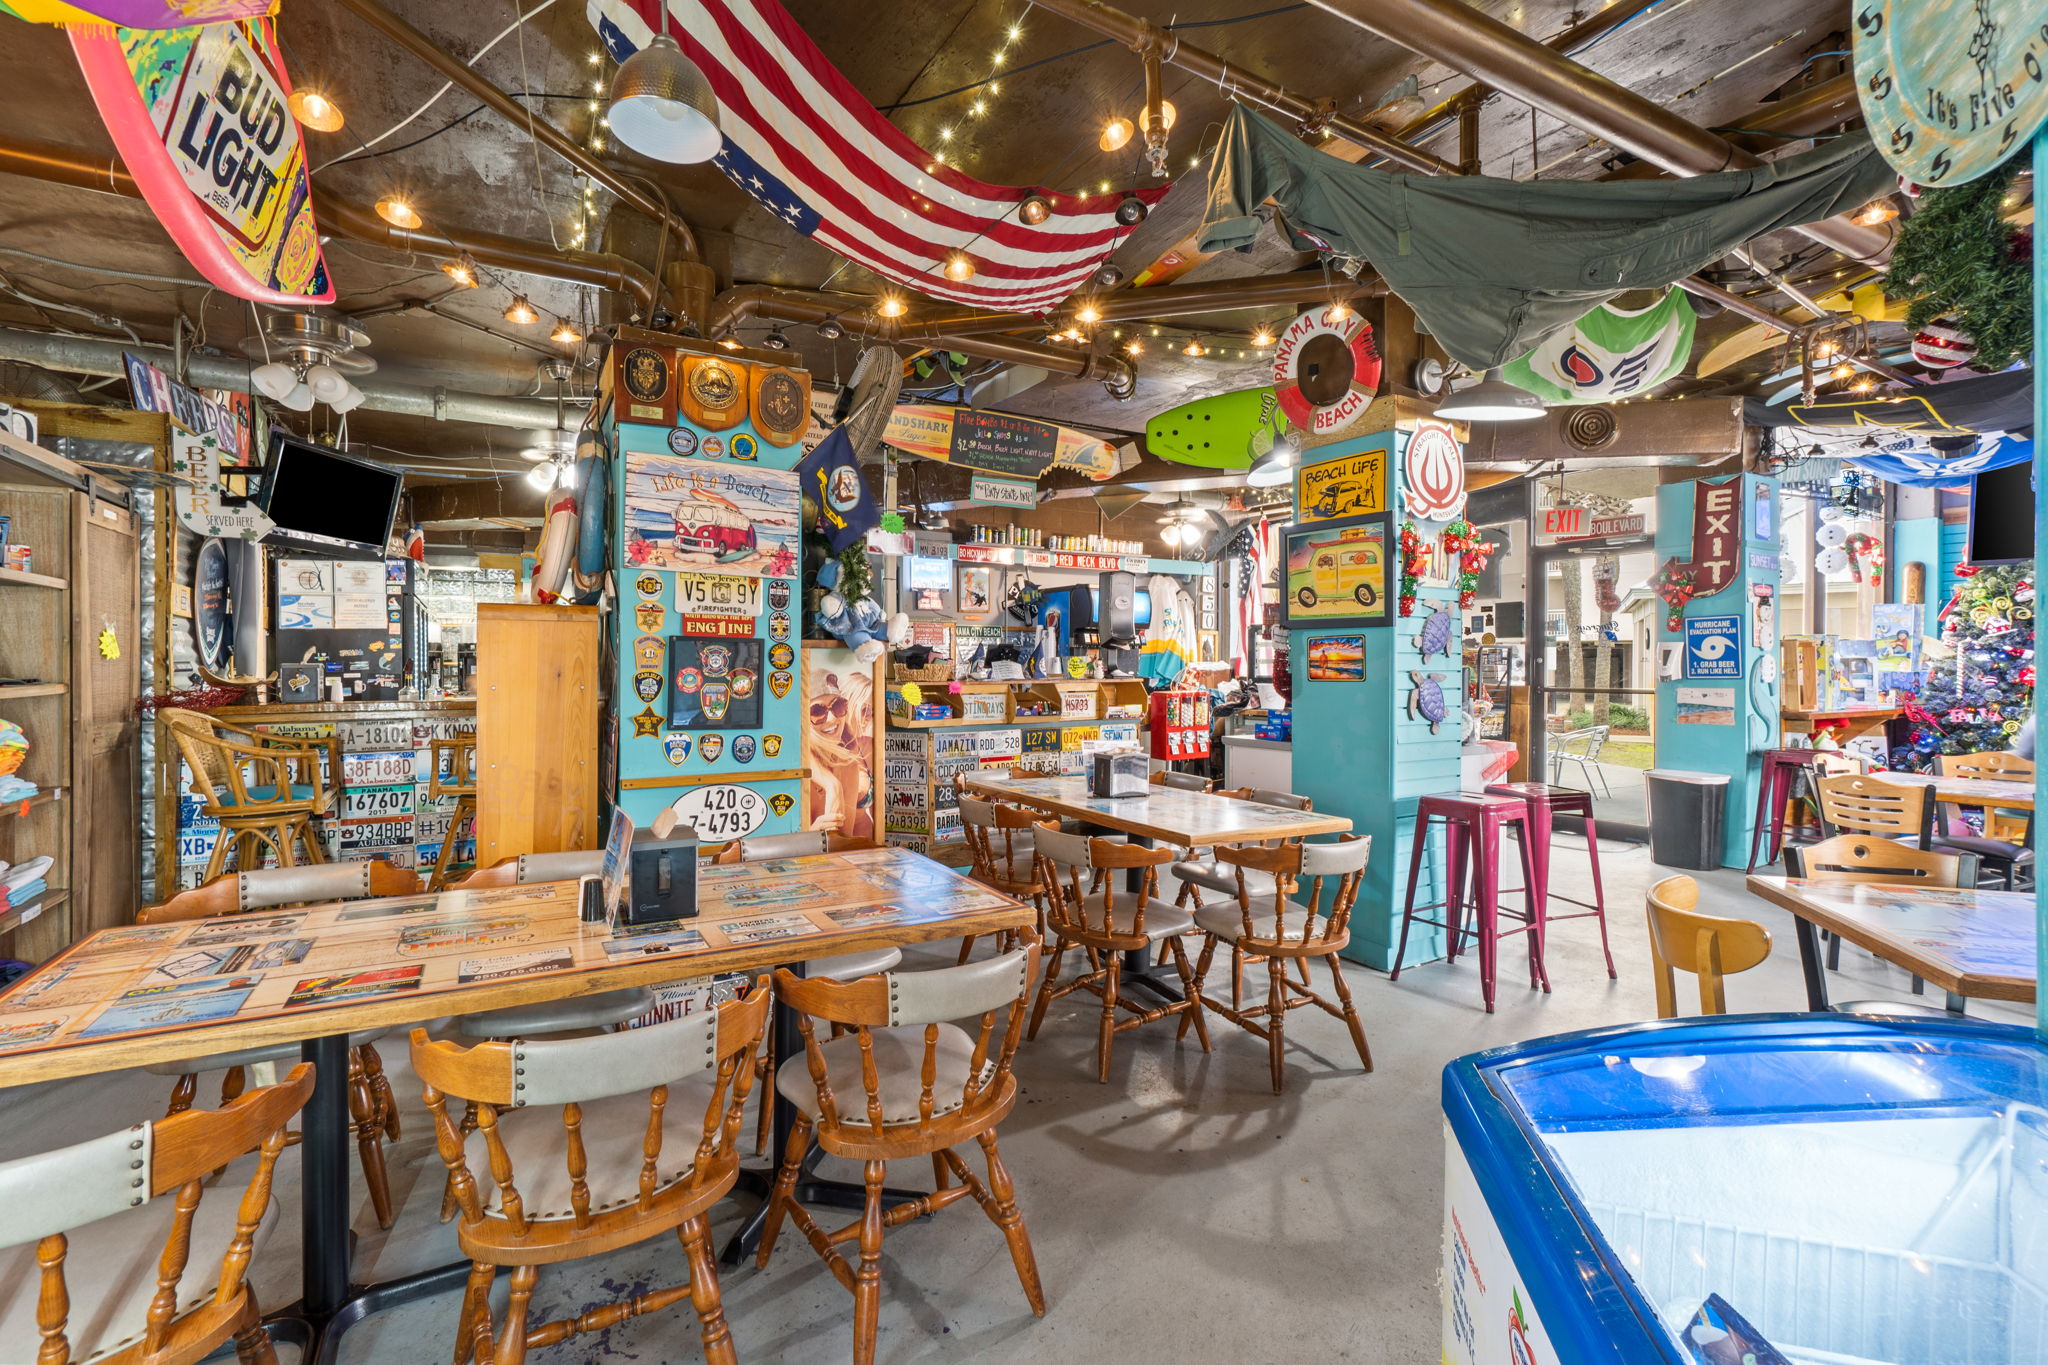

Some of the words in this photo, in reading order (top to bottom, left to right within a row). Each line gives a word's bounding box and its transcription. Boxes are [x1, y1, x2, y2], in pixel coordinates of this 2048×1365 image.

[215, 46, 286, 156] BUD
[178, 92, 278, 218] LIGHT
[211, 190, 230, 211] BEER
[1275, 315, 1315, 381] PANAMA
[1316, 393, 1363, 429] BEACH
[187, 446, 210, 514] BEER
[1306, 464, 1346, 485] BEACH
[710, 476, 719, 488] a
[206, 515, 235, 527] SERVED
[236, 516, 254, 527] HERE
[1545, 509, 1582, 533] EXIT
[1591, 518, 1642, 534] BOULEVARD
[1702, 489, 1732, 584] EXIT
[1060, 555, 1073, 566] RED
[1077, 556, 1095, 567] NECK
[1099, 558, 1116, 569] BLVD
[1750, 554, 1771, 568] SUNSET
[699, 573, 717, 581] New
[718, 574, 742, 583] Jersey
[685, 581, 705, 602] V5
[697, 605, 742, 613] FIREFIGHTER
[1694, 620, 1731, 628] HURRICANE
[971, 627, 982, 636] CITY
[983, 627, 1000, 637] BEACH
[1005, 738, 1020, 748] 528
[1026, 732, 1040, 745] 127
[919, 765, 924, 778] 4
[346, 792, 409, 811] 167607
[704, 789, 736, 810] 420
[358, 838, 398, 847] AUBURN
[421, 852, 438, 866] 58
[127, 984, 177, 997] ONE
[661, 990, 697, 1000] Illinois
